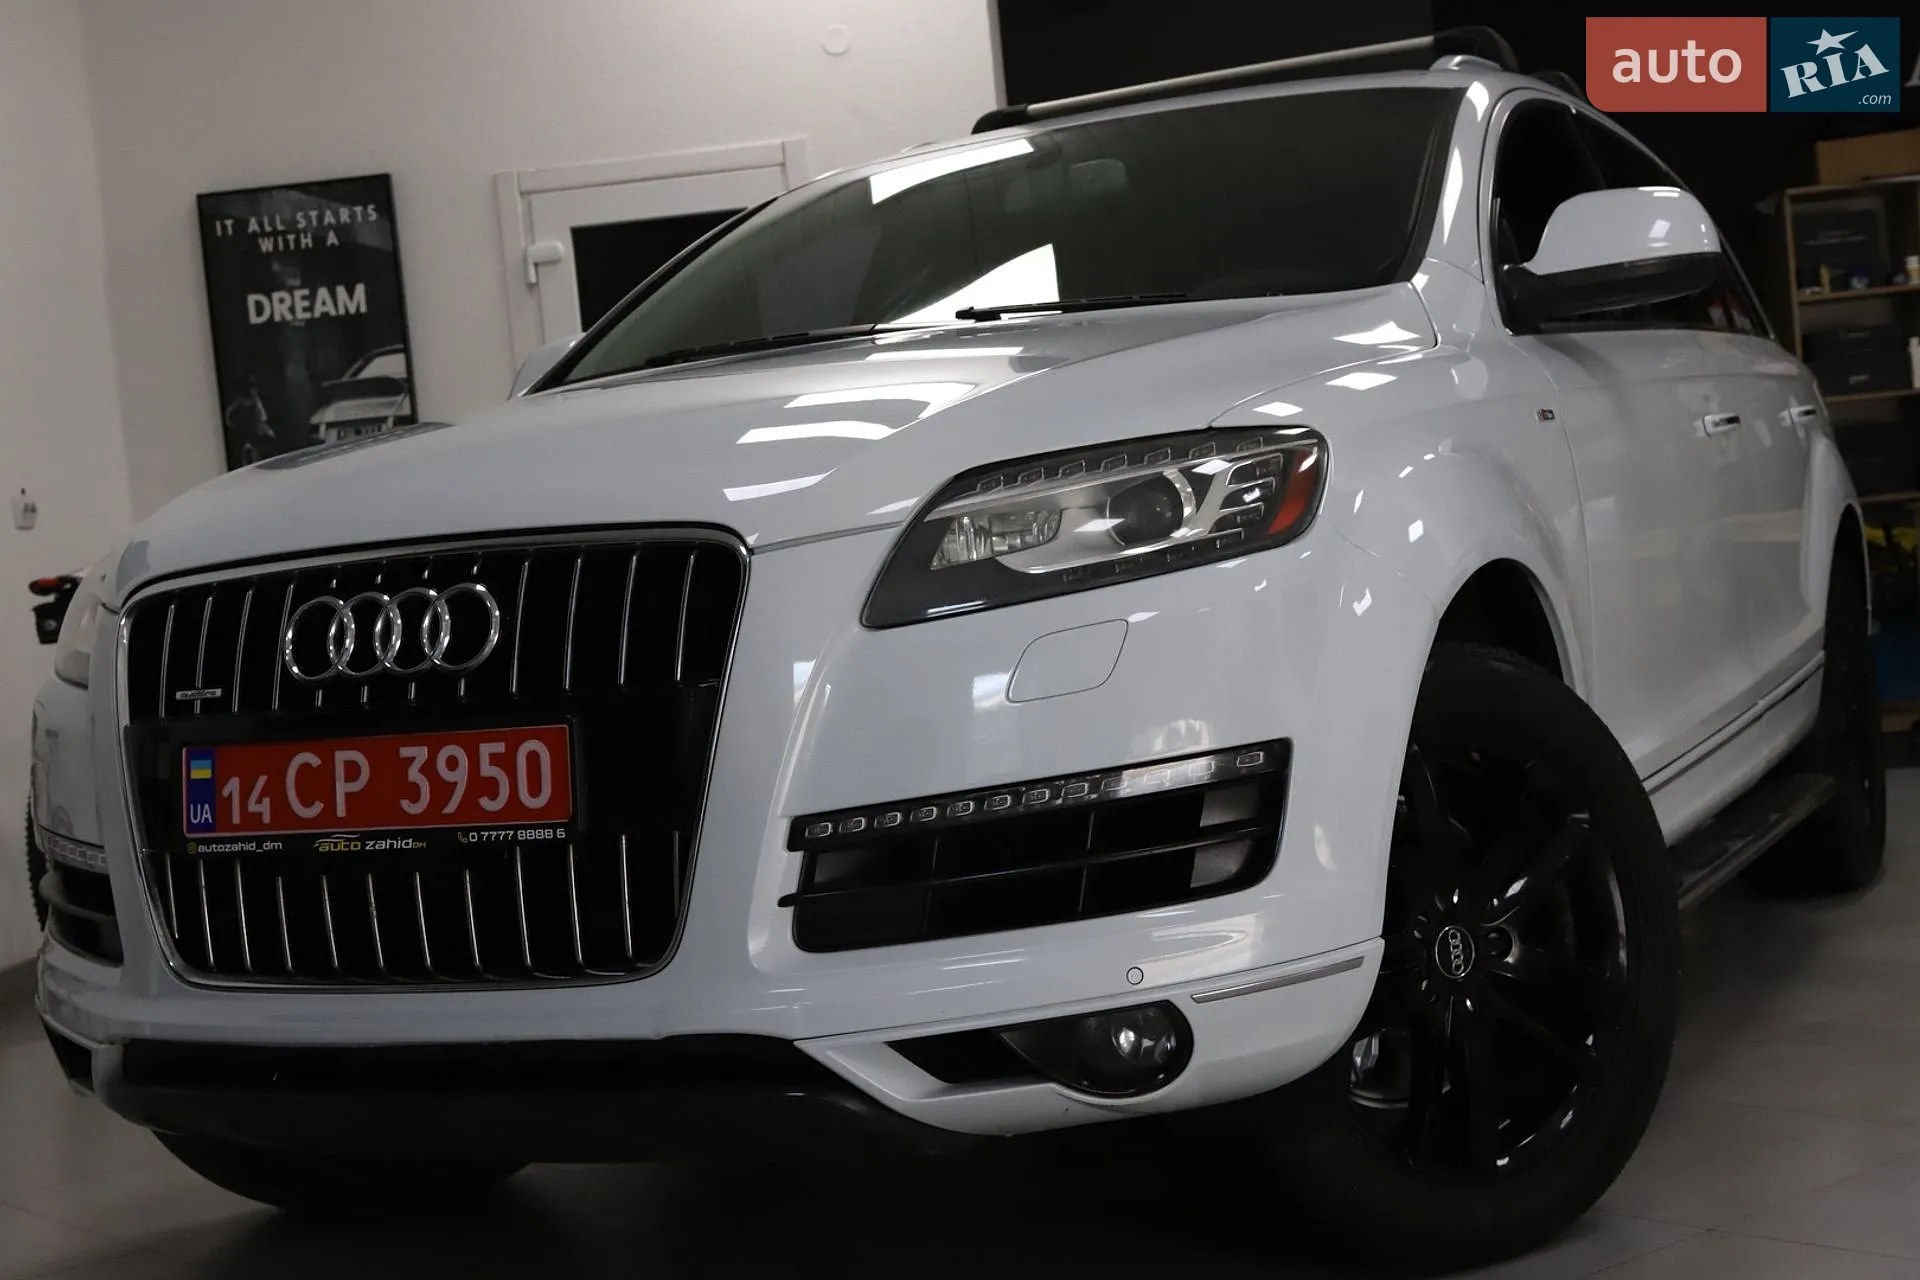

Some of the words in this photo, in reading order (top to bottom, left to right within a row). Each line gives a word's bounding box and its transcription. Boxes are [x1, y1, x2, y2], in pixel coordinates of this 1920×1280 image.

[215, 218, 235, 237] IT
[248, 216, 286, 234] ALL
[296, 204, 379, 229] STARTS
[258, 232, 313, 253] WITH
[326, 229, 340, 247] A
[247, 283, 368, 325] DREAM
[222, 775, 271, 825] 14
[286, 750, 371, 818] CP
[399, 739, 552, 815] 3950
[190, 803, 213, 824] UA
[318, 838, 362, 852] auto
[481, 830, 515, 842] 7777
